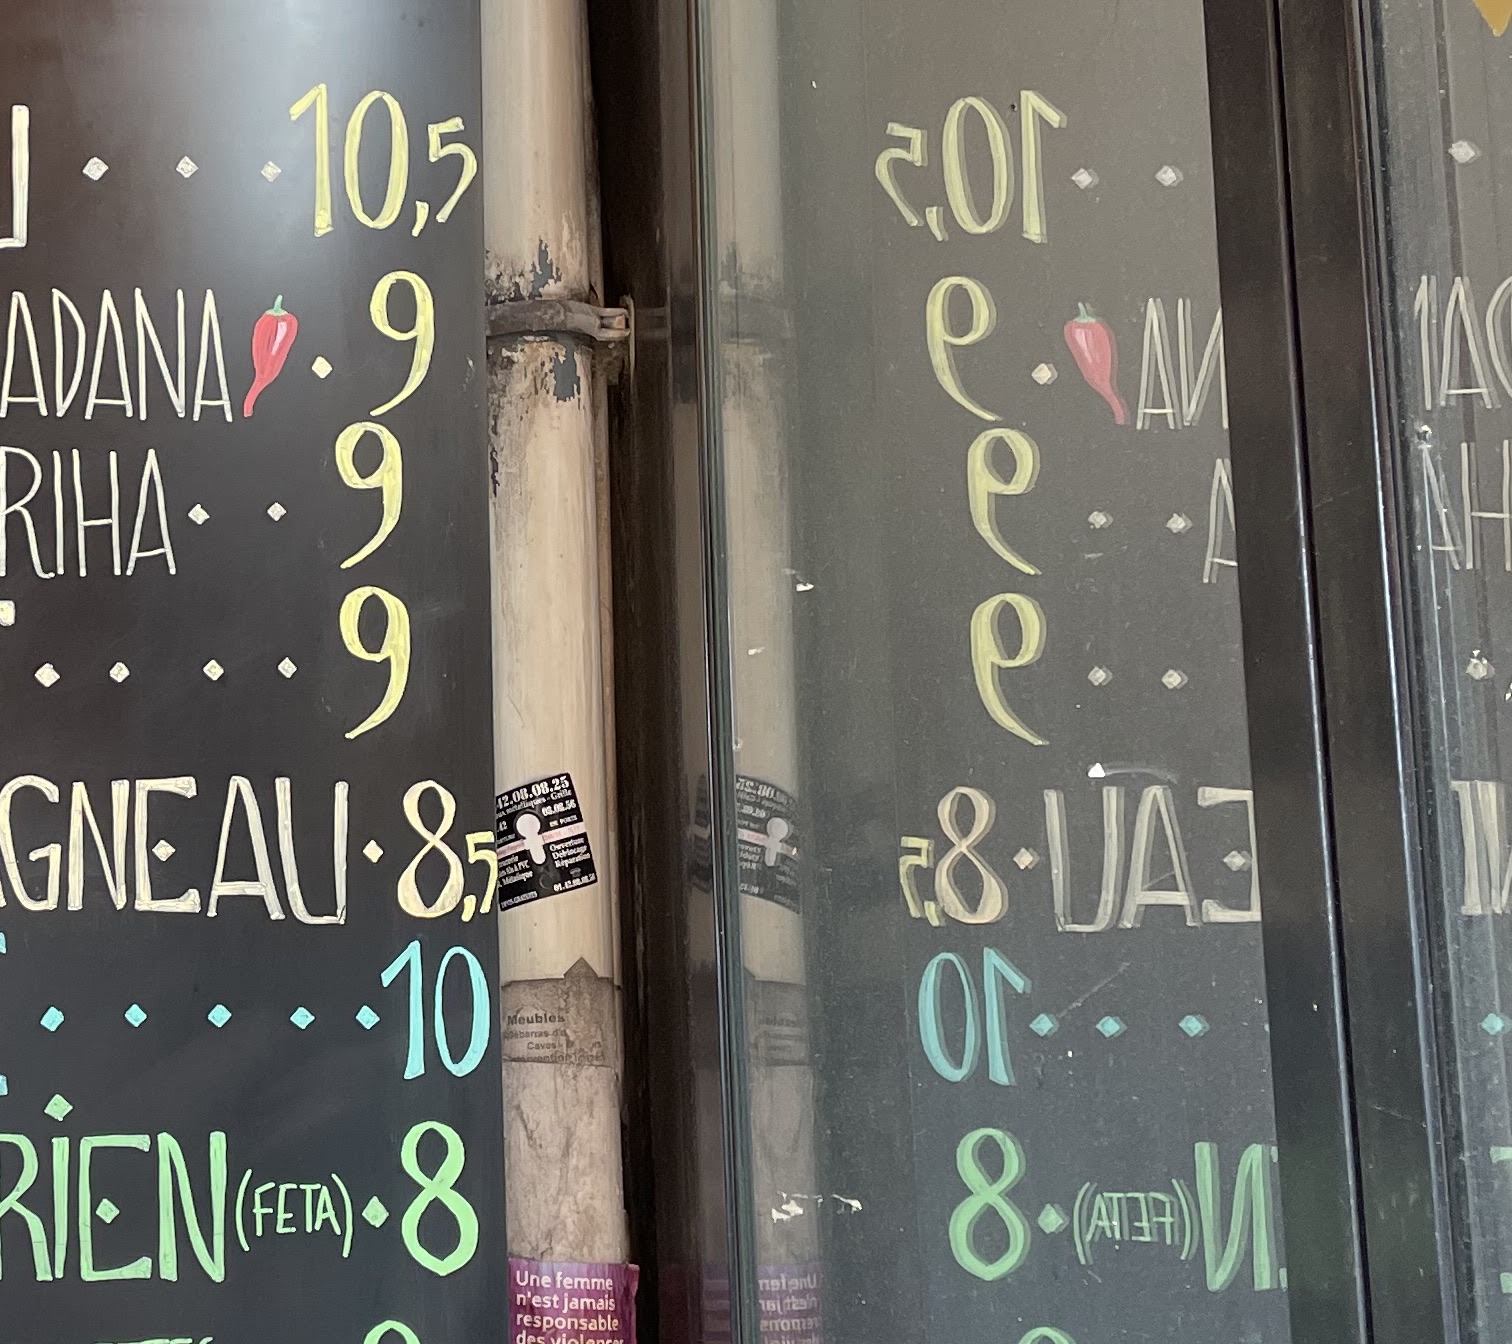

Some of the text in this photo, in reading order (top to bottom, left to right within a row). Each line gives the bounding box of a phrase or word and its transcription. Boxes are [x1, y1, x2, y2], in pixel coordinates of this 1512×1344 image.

[288, 83, 478, 237] 10,5
[0, 288, 233, 422] ADANA
[368, 270, 436, 417] 9
[335, 422, 403, 570] 9
[338, 586, 413, 740] 9
[397, 779, 499, 923] 8,5
[379, 938, 490, 1080] 10
[235, 1169, 355, 1258] (FETA)
[400, 1121, 480, 1277] 8
[516, 1270, 614, 1291] Une femme
[516, 1291, 616, 1314] n'est jamais
[516, 1314, 619, 1332] responsable
